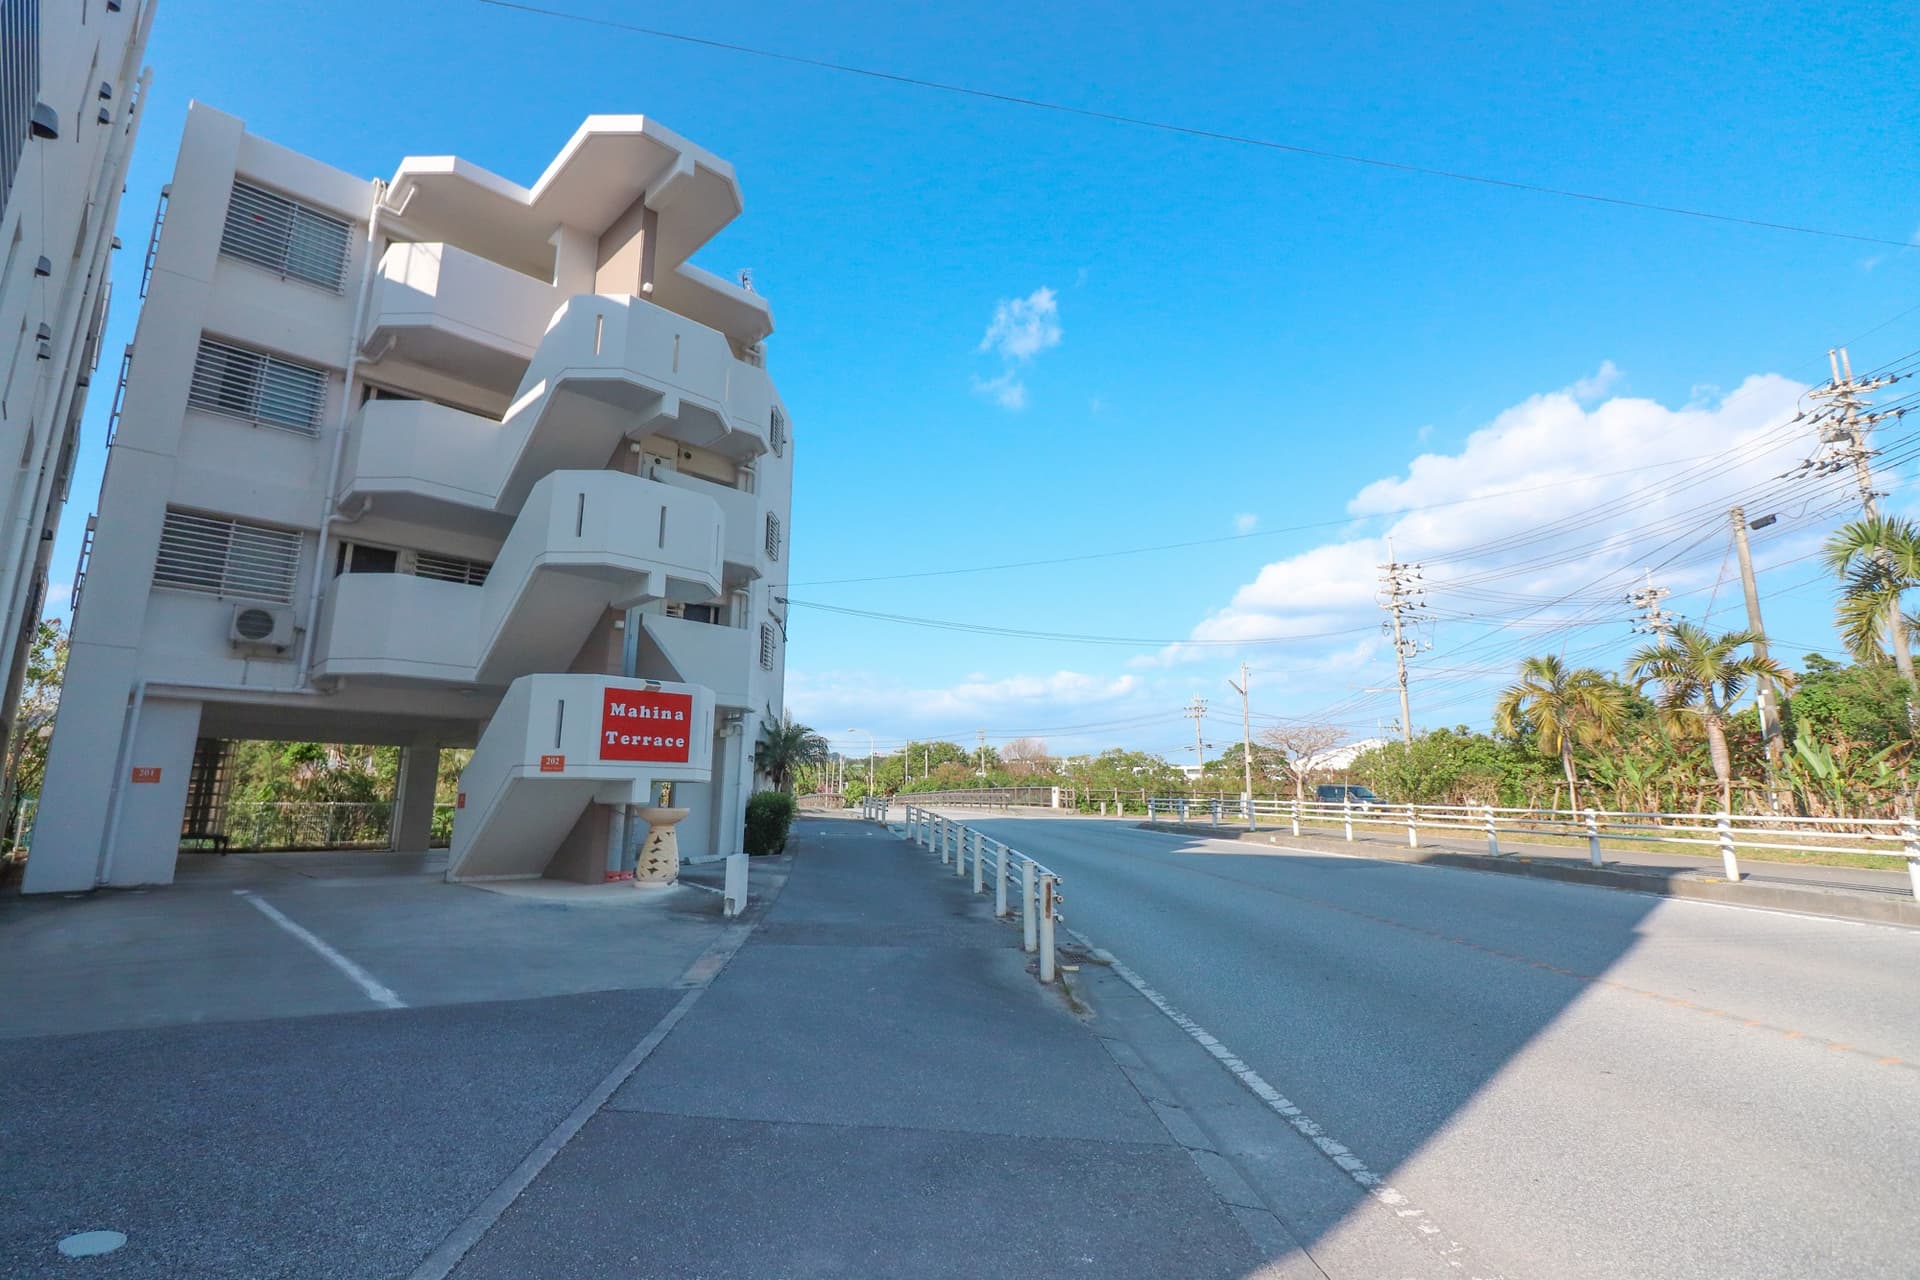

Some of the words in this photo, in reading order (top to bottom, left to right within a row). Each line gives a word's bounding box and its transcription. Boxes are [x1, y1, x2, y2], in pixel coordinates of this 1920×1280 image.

[610, 702, 684, 720] Mahina
[605, 730, 685, 748] Terrace
[545, 756, 560, 765] 202
